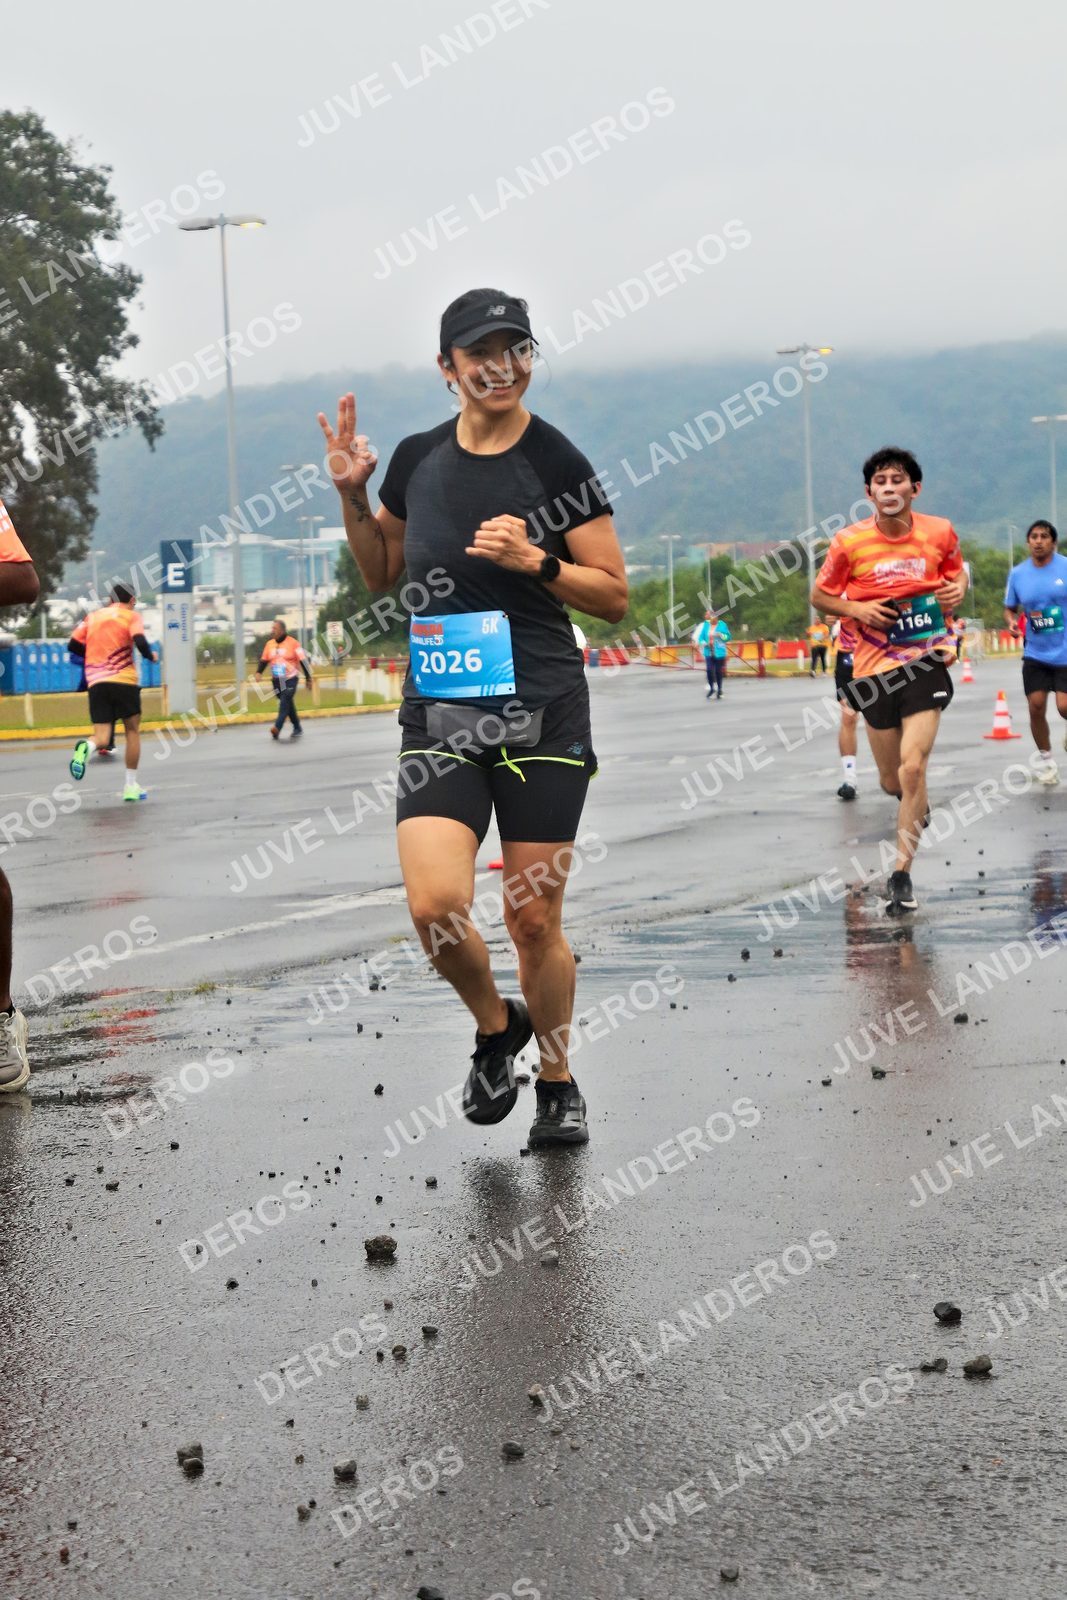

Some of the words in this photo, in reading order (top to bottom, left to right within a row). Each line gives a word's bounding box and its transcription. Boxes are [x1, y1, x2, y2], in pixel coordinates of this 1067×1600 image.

[167, 562, 186, 586] E
[897, 613, 932, 631] 1164
[418, 648, 483, 675] 2026
